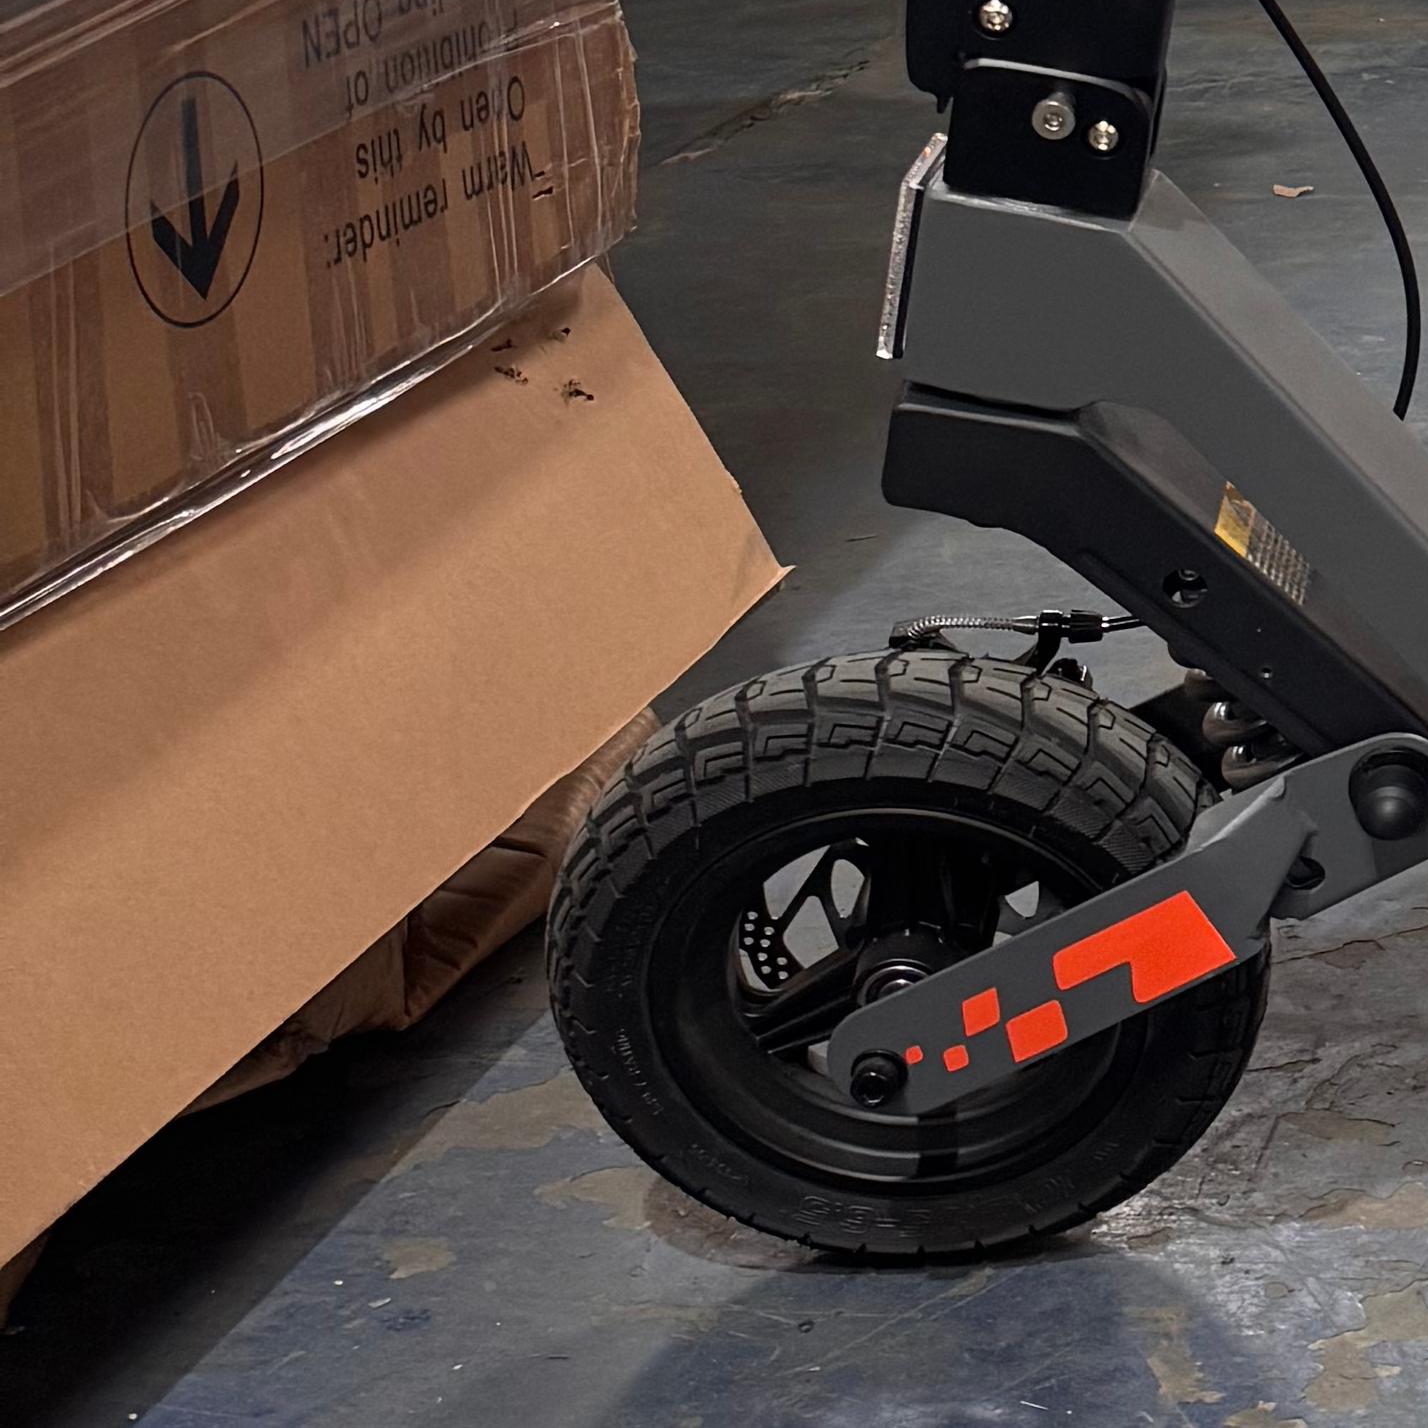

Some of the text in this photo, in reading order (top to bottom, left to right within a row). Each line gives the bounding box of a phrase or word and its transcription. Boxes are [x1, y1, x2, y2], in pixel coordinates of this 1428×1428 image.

[343, 68, 370, 118] of
[355, 127, 403, 183] this
[417, 105, 447, 155] by
